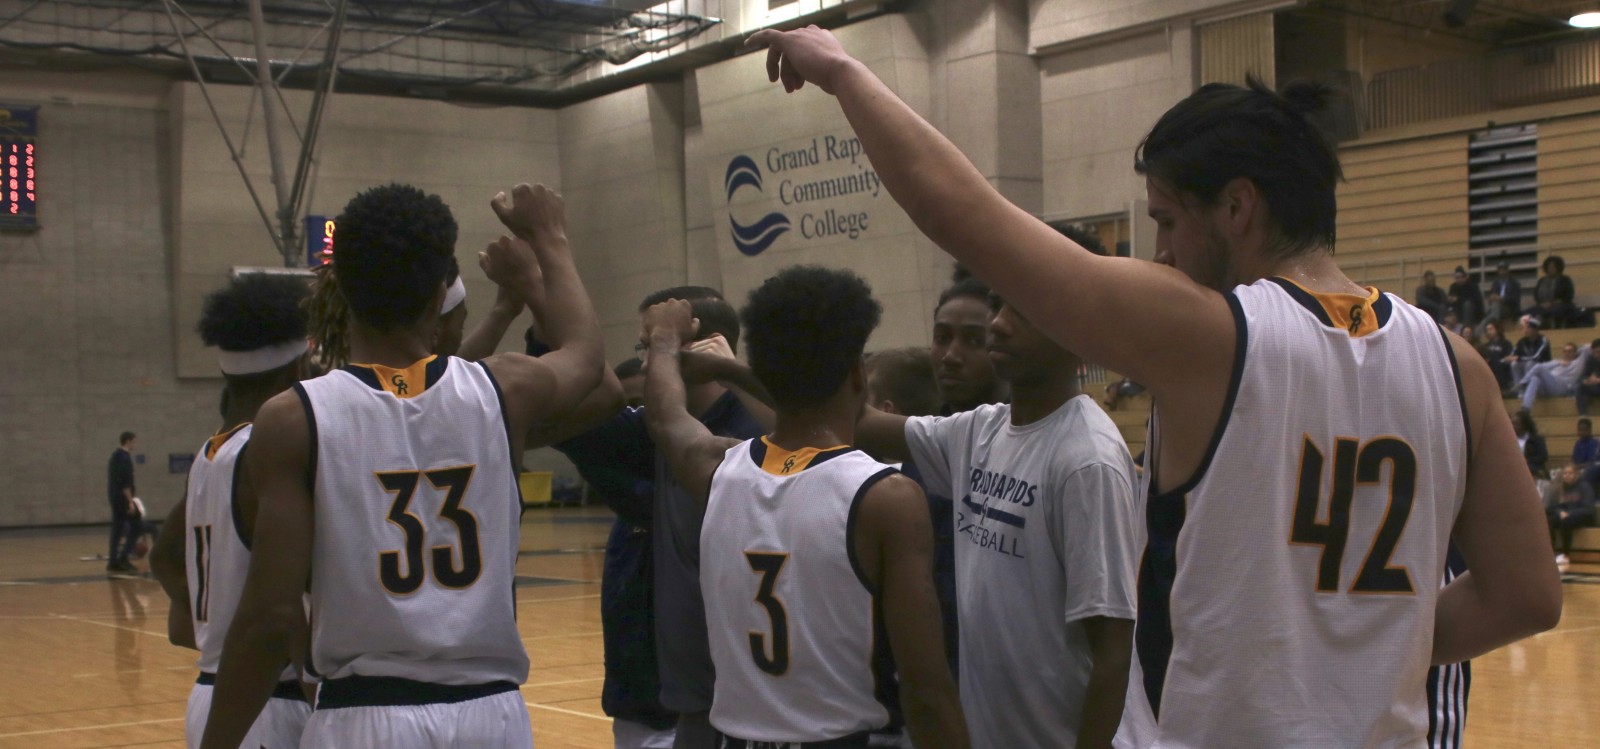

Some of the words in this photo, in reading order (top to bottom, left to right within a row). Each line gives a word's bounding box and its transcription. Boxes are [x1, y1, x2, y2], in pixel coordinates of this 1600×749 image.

[765, 138, 820, 174] Grand
[823, 134, 864, 165] Rap
[778, 165, 881, 206] Community
[800, 208, 869, 240] College
[373, 464, 483, 596] 33
[1287, 432, 1417, 596] 42
[743, 550, 791, 677] 3
